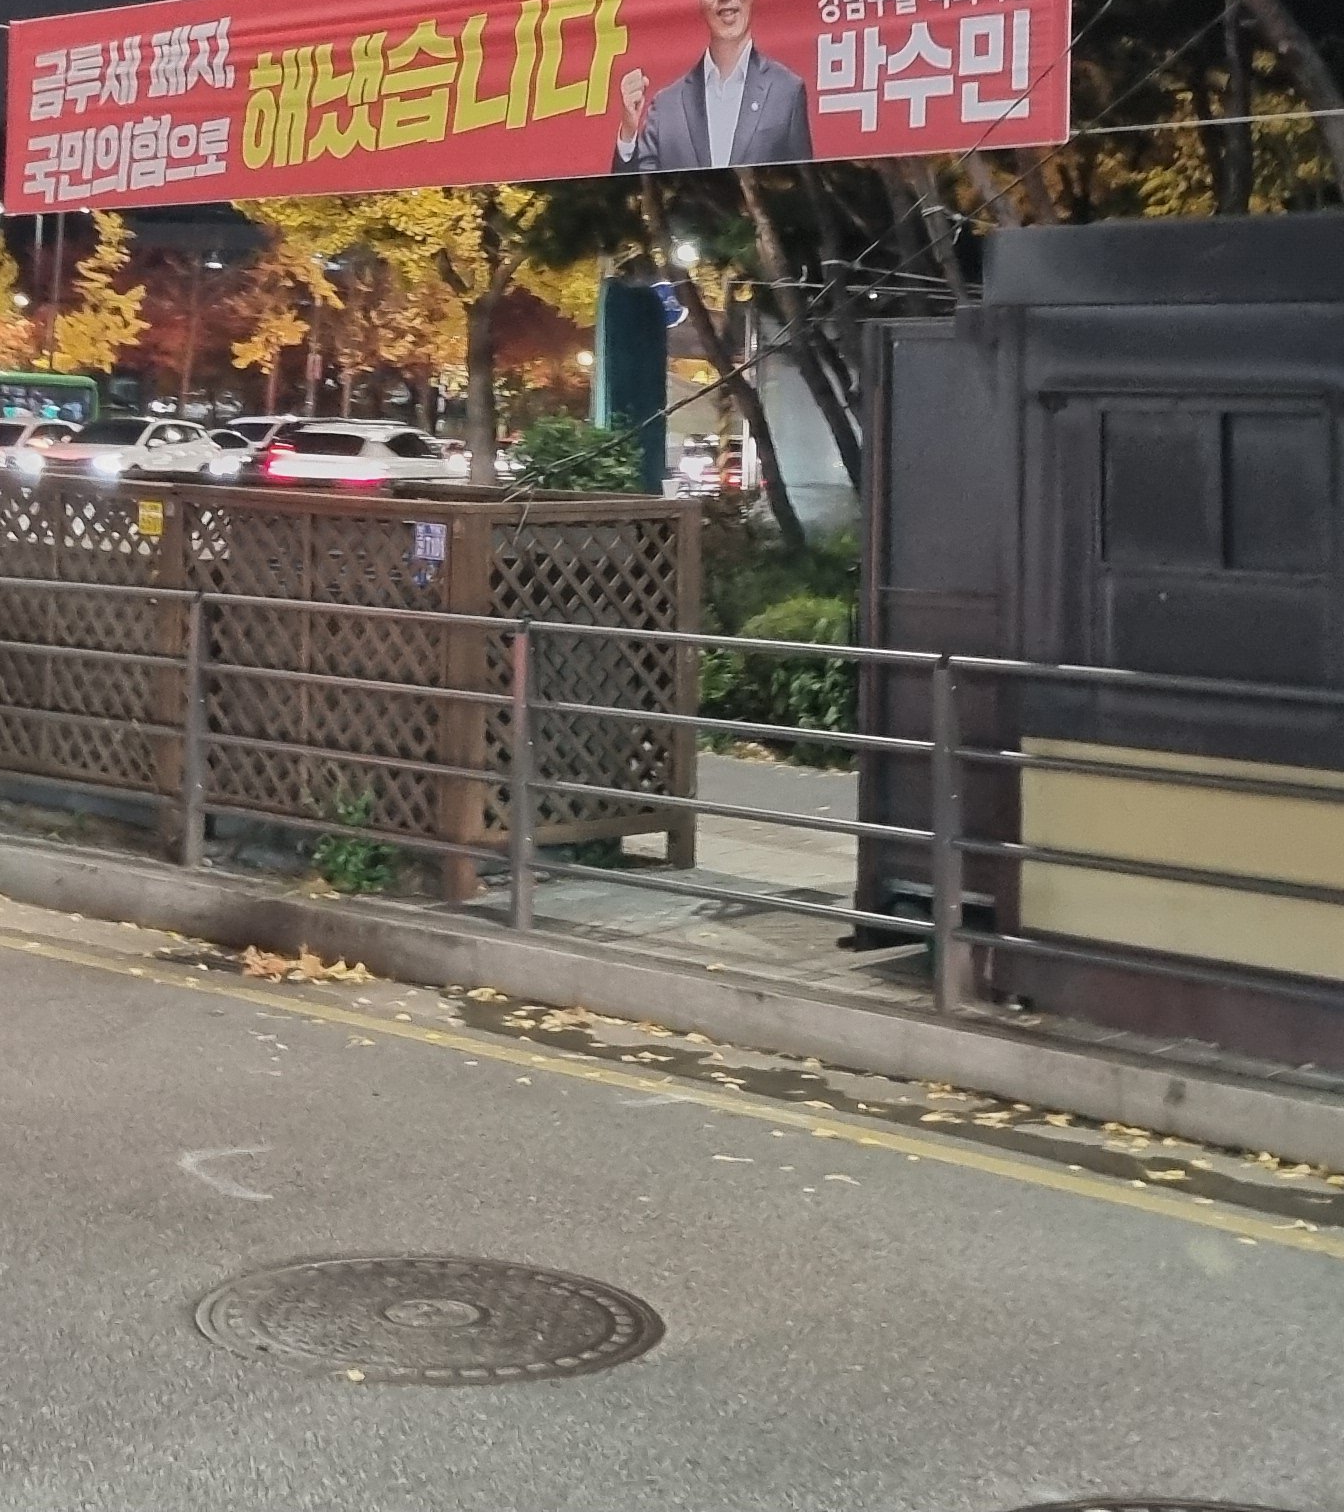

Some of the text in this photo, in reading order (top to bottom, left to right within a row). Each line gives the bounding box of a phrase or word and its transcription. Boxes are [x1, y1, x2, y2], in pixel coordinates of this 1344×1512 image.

[29, 34, 142, 121] 금투세
[816, 8, 1031, 133] 박수민
[22, 114, 231, 204] 국민의힘으로
